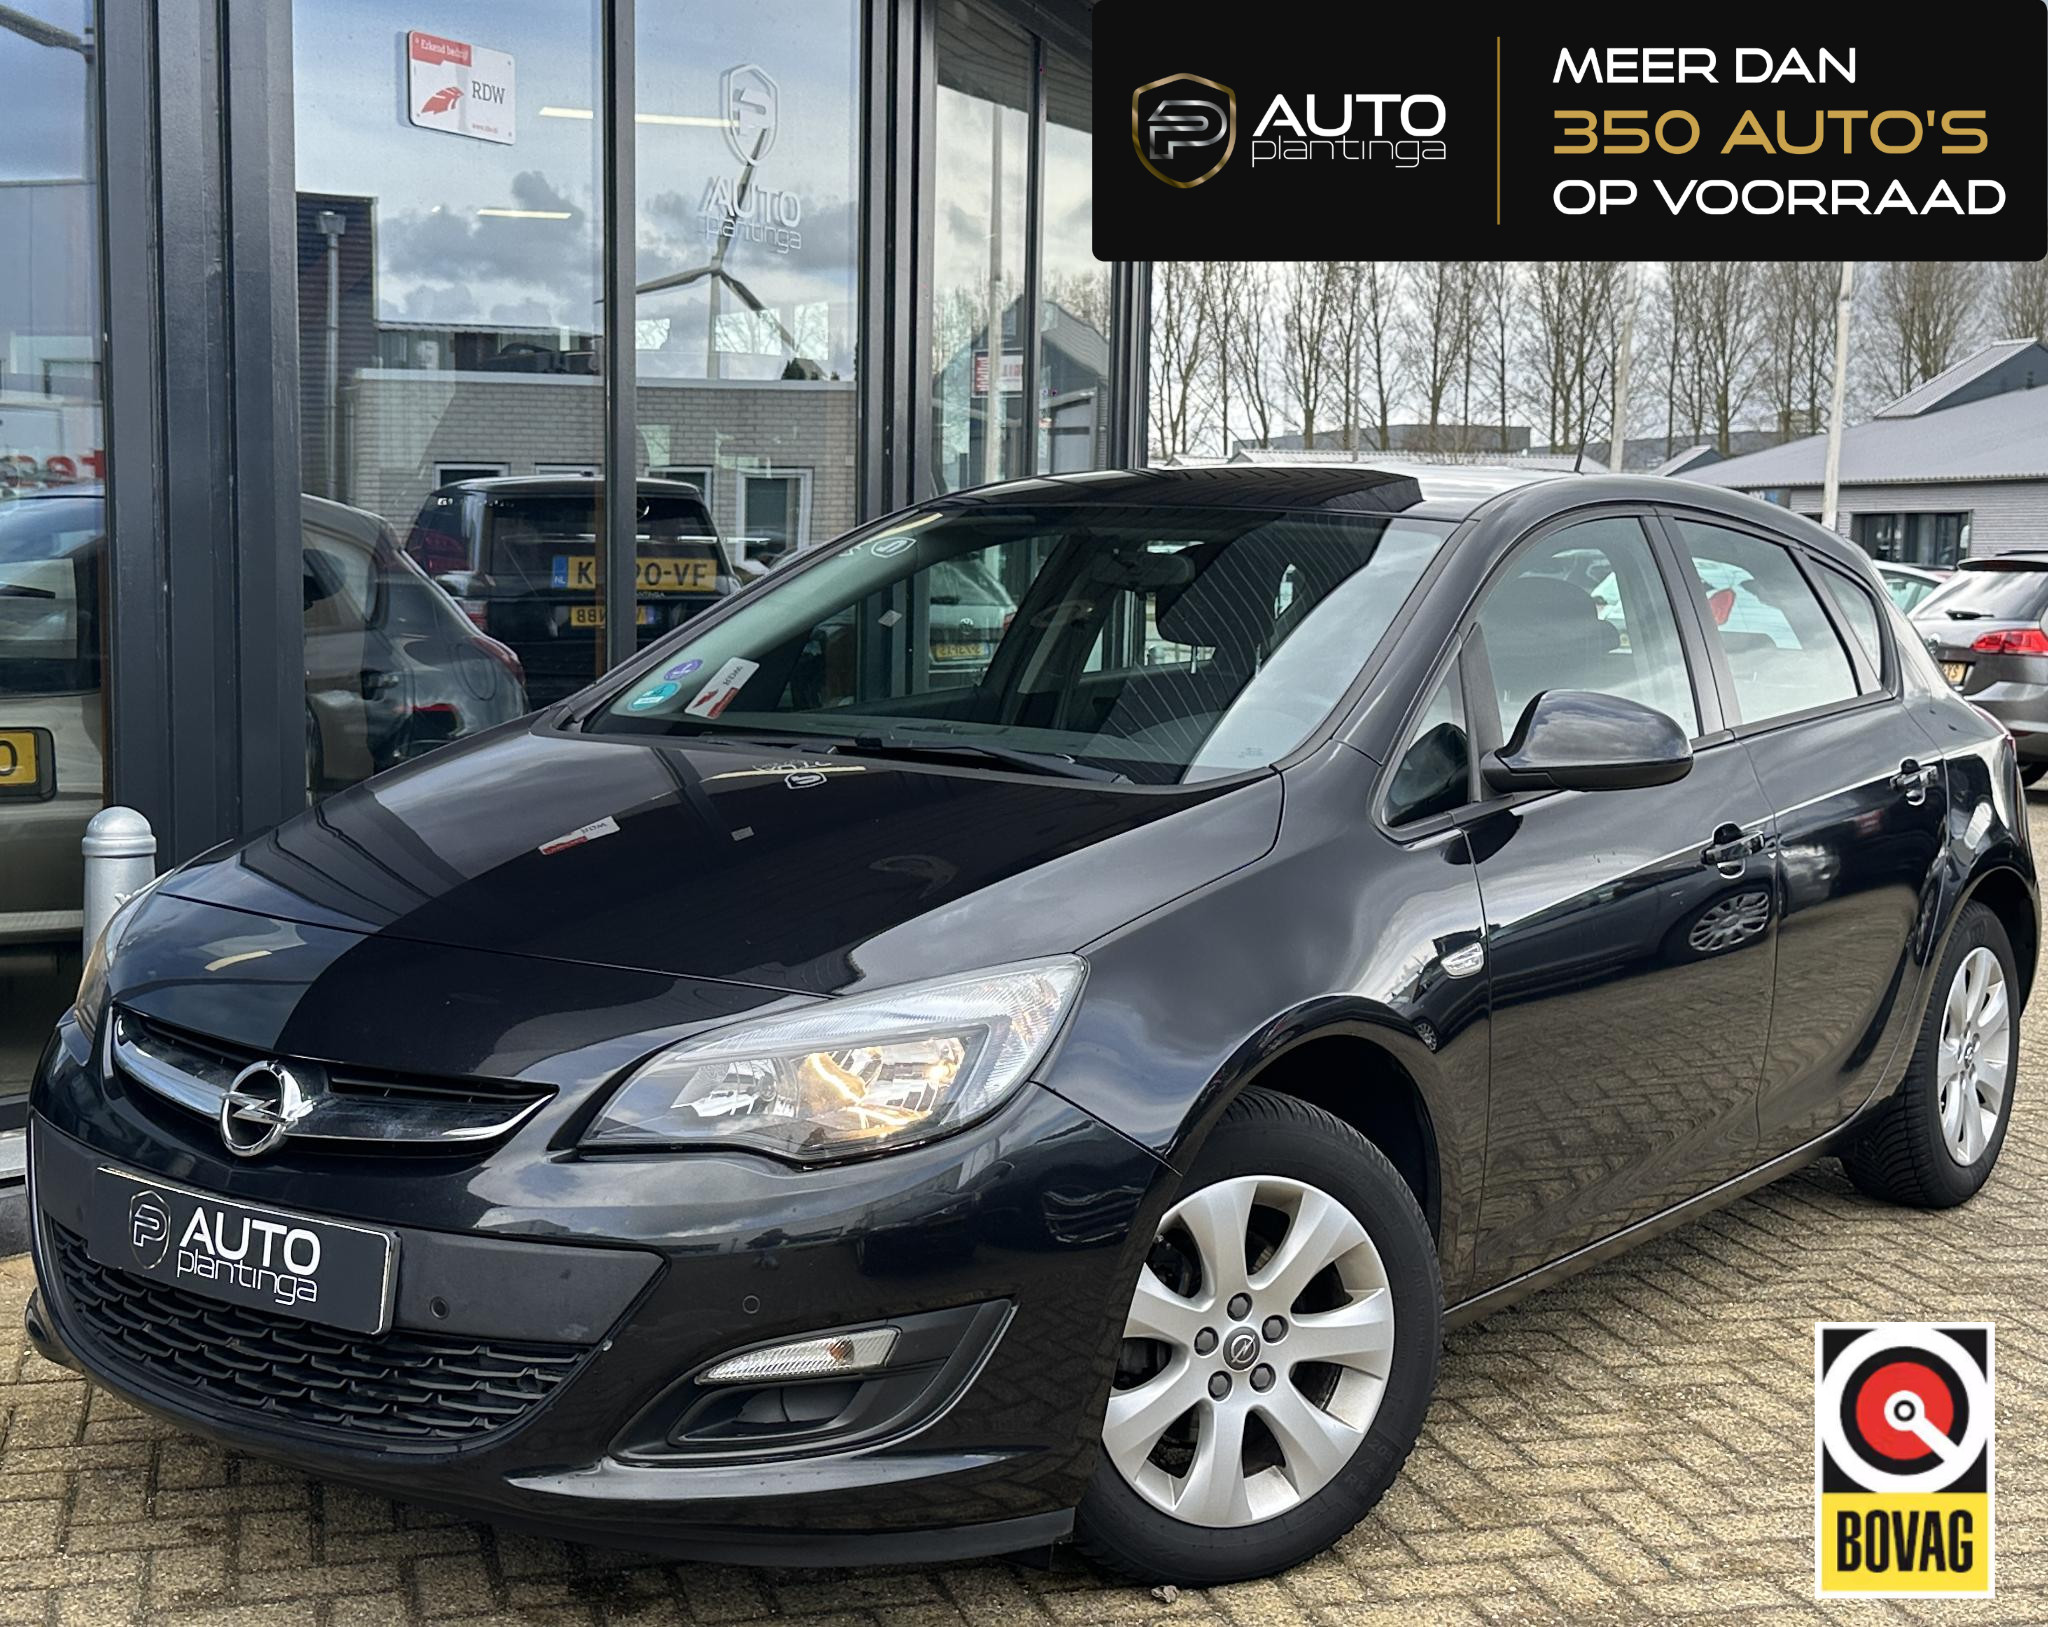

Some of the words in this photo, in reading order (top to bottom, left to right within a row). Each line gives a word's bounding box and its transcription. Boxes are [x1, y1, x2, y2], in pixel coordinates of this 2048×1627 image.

[420, 39, 446, 54] Erkend
[472, 80, 506, 105] RDW
[706, 176, 801, 228] AUTO
[705, 216, 801, 254] plantinga
[554, 574, 566, 585] NL
[179, 1206, 321, 1276] AUTO
[176, 1249, 318, 1306] plantinga
